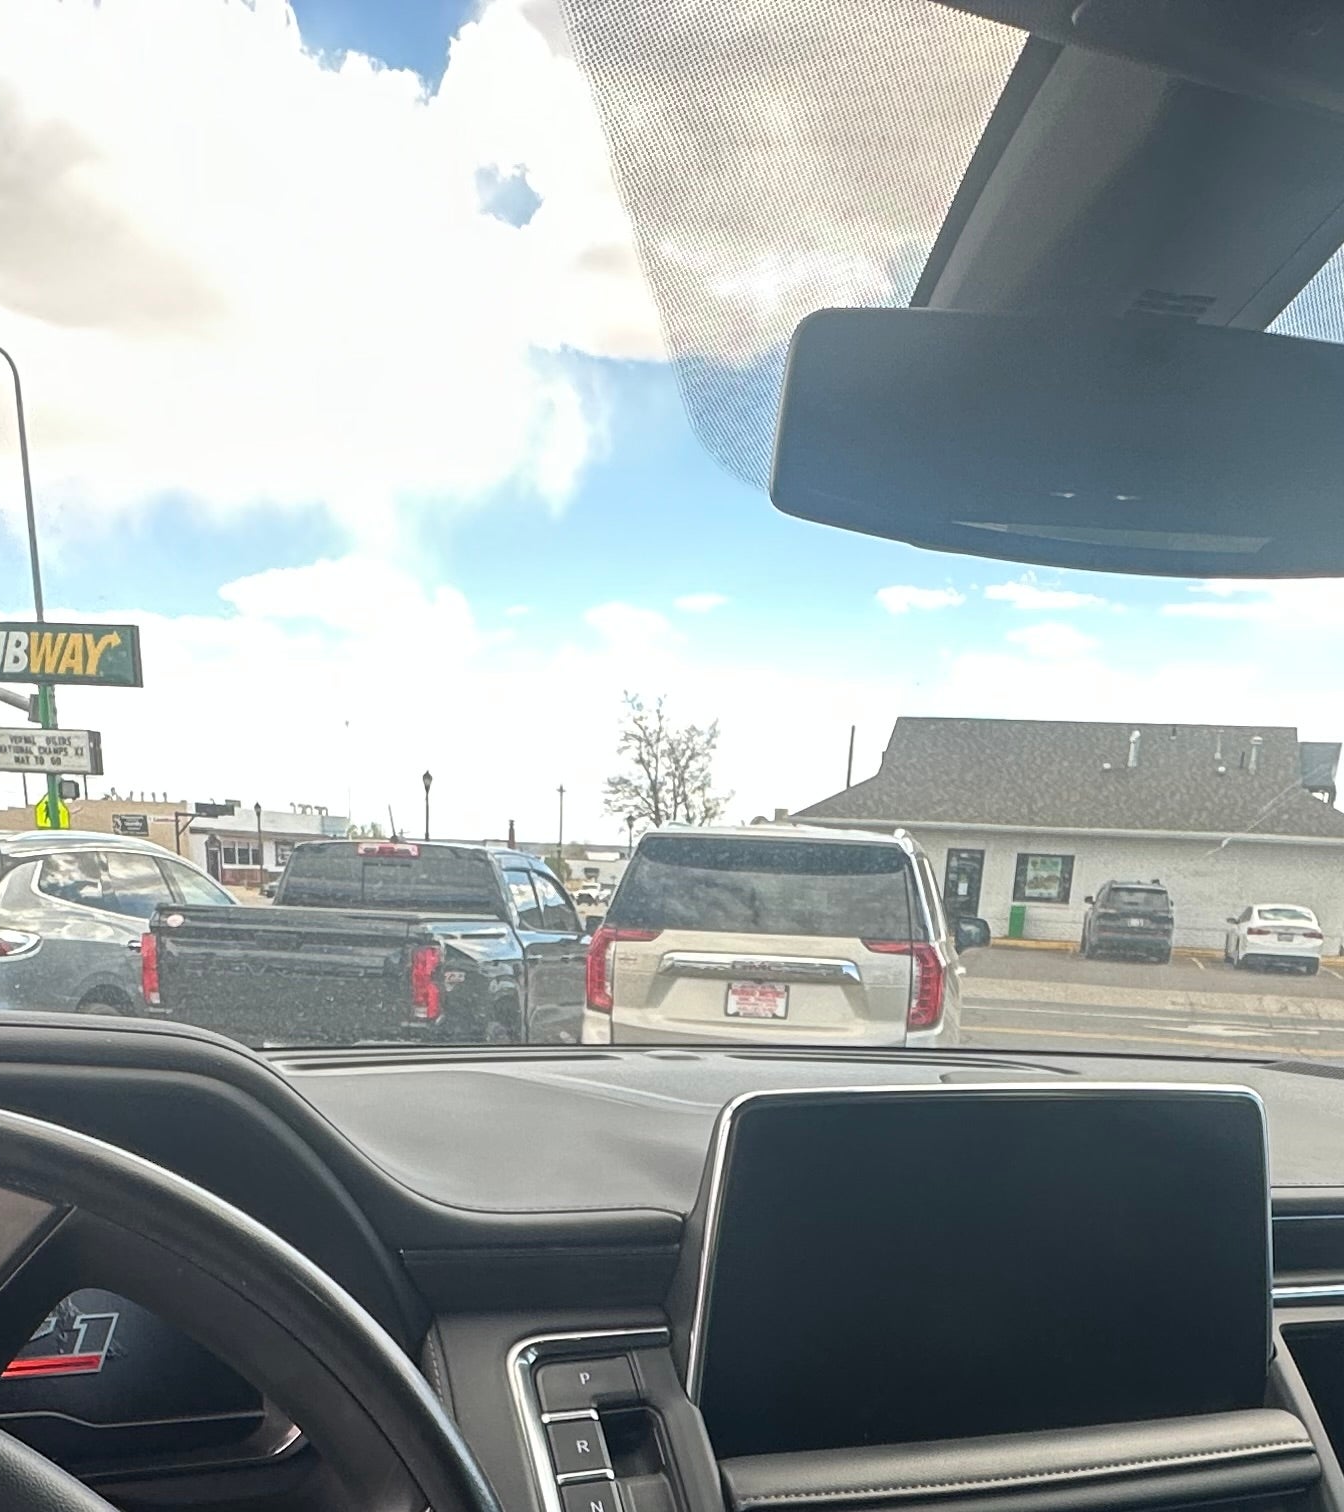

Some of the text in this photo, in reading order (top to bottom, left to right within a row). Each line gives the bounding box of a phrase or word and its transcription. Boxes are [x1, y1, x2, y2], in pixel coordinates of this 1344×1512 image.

[35, 756, 45, 766] TO
[578, 1371, 591, 1385] P
[575, 1439, 590, 1454] R
